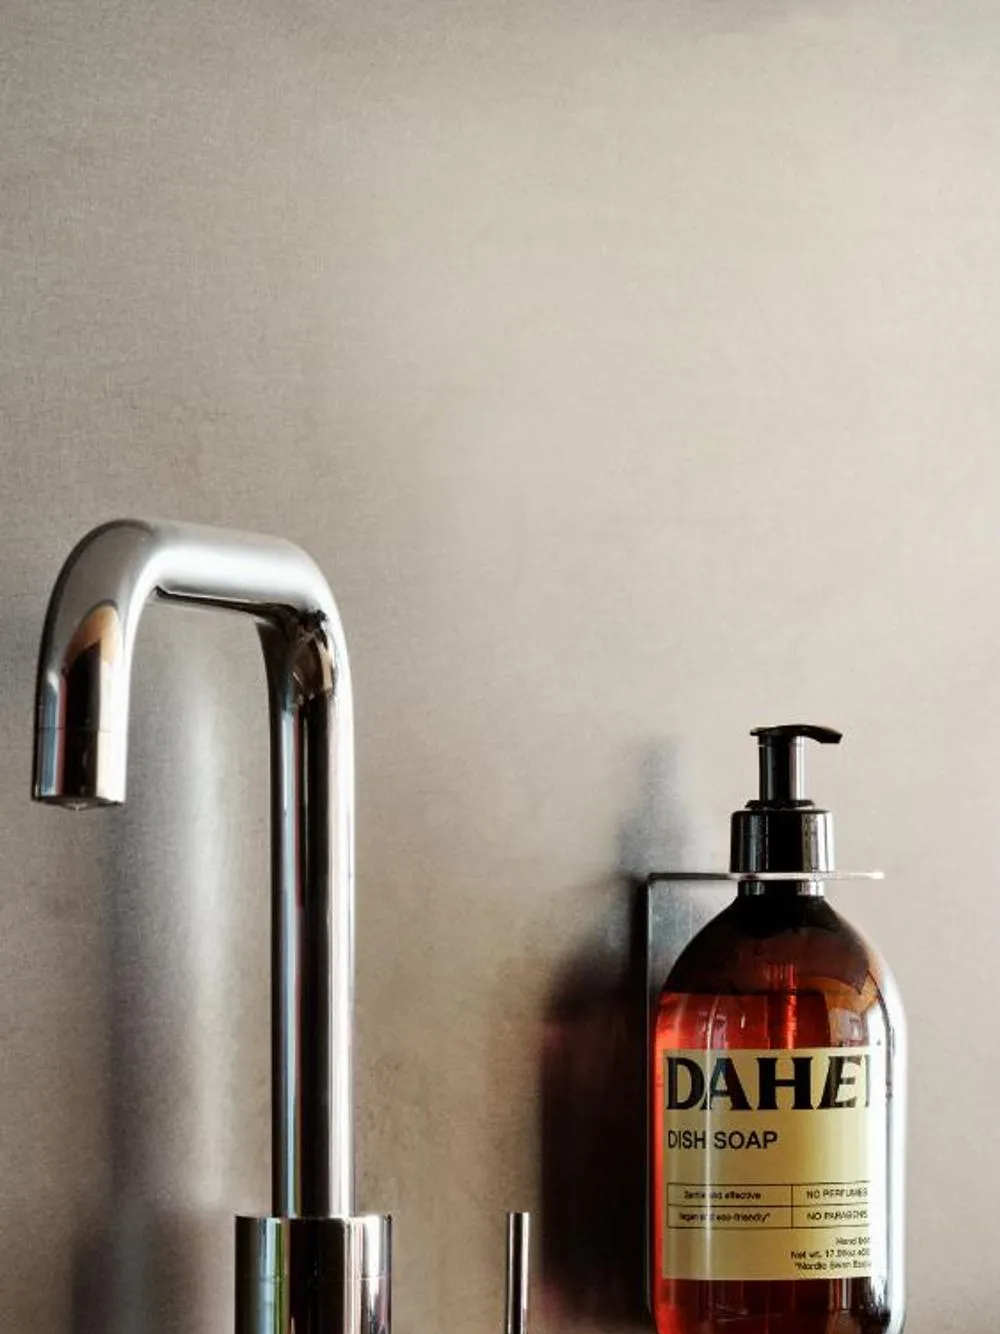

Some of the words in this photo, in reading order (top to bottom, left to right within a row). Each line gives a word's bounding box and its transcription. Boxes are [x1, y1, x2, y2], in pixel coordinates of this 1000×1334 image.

[666, 1055, 871, 1111] DAHE
[668, 1130, 706, 1150] DISH
[714, 1130, 779, 1150] SOAP
[806, 1190, 821, 1200] NO
[806, 1212, 822, 1221] NO
